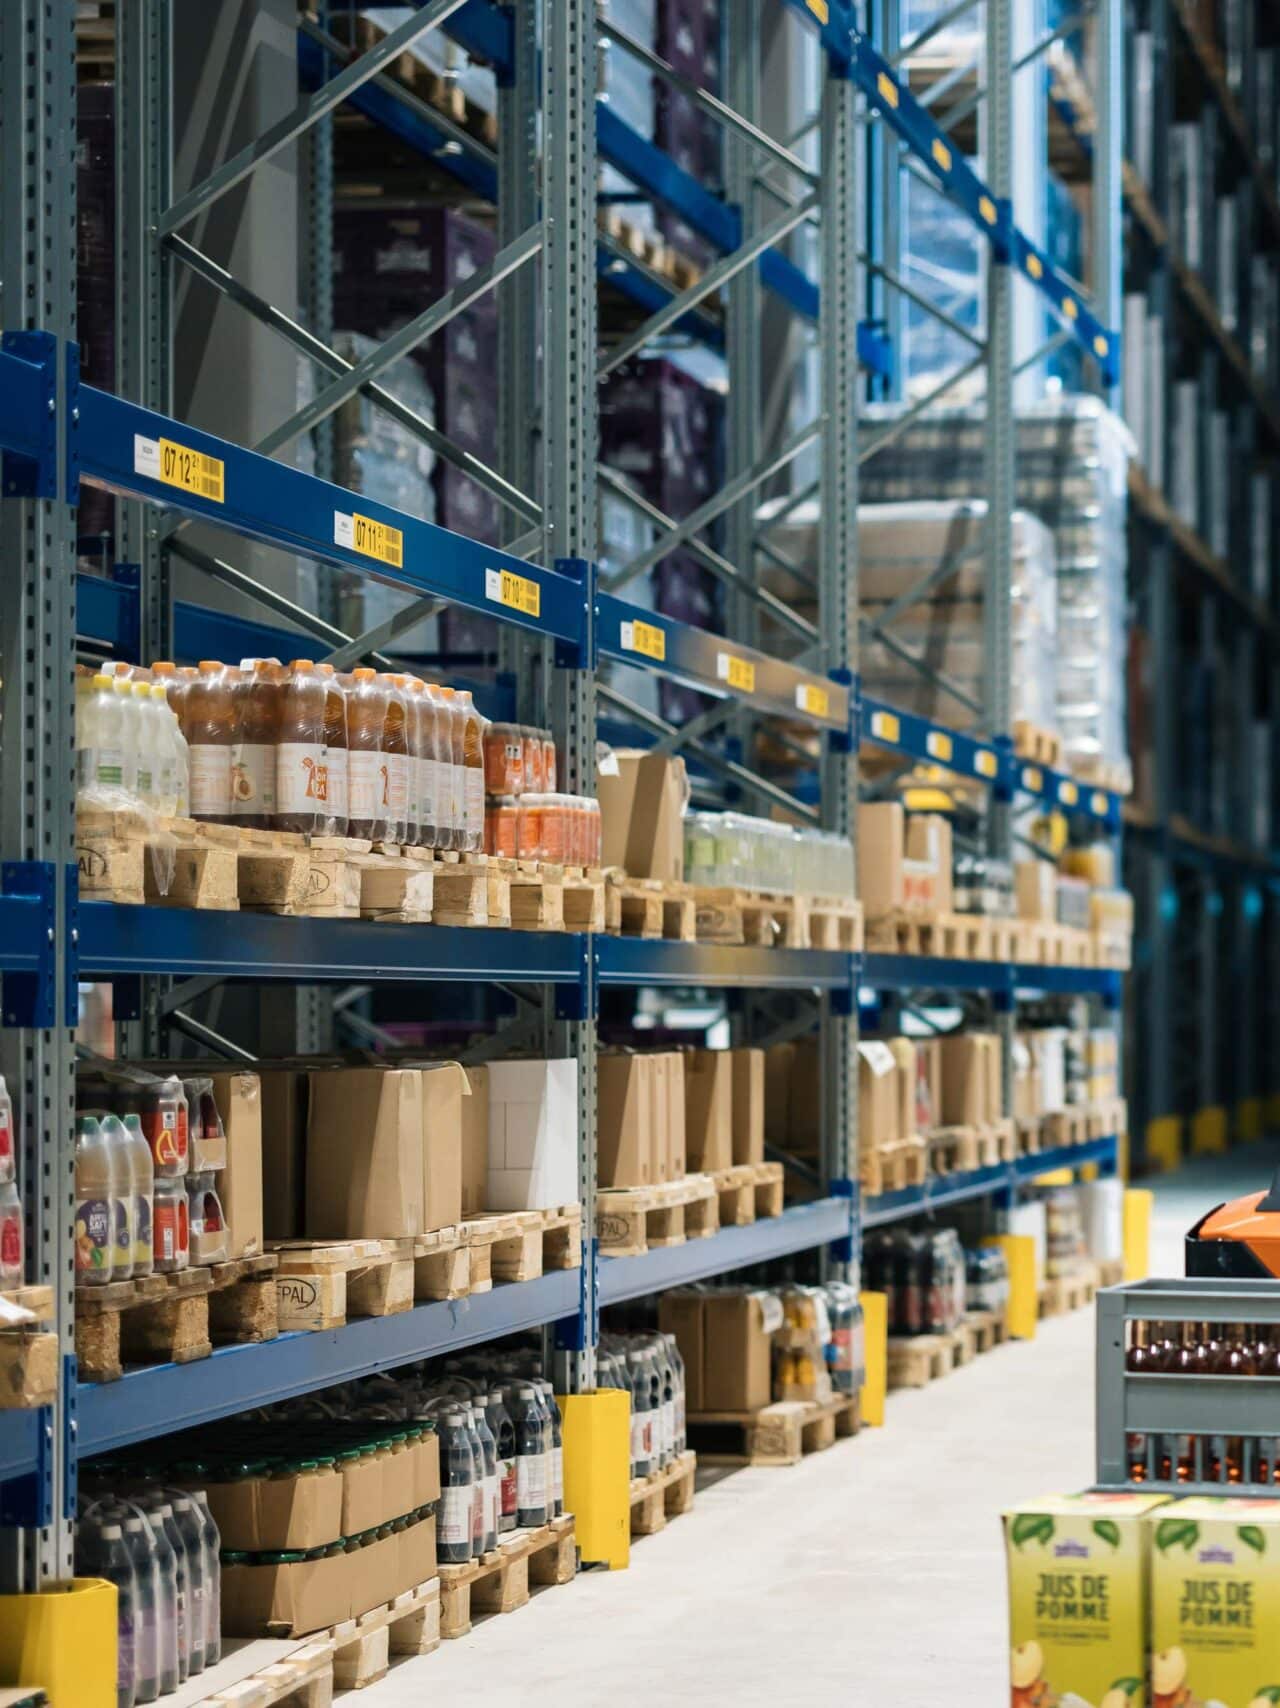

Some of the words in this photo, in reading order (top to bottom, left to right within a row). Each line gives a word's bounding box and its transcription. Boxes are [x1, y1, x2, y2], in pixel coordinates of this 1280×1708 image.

[164, 446, 176, 478] 07
[179, 451, 191, 484] 12
[356, 519, 367, 548] 07
[368, 524, 377, 553] 11
[1036, 1573, 1076, 1598] JUS
[1081, 1575, 1109, 1600] DE
[1179, 1580, 1220, 1604] JUS
[1225, 1581, 1253, 1606] DE
[1035, 1600, 1110, 1621] POMME
[1179, 1606, 1254, 1629] POMME
